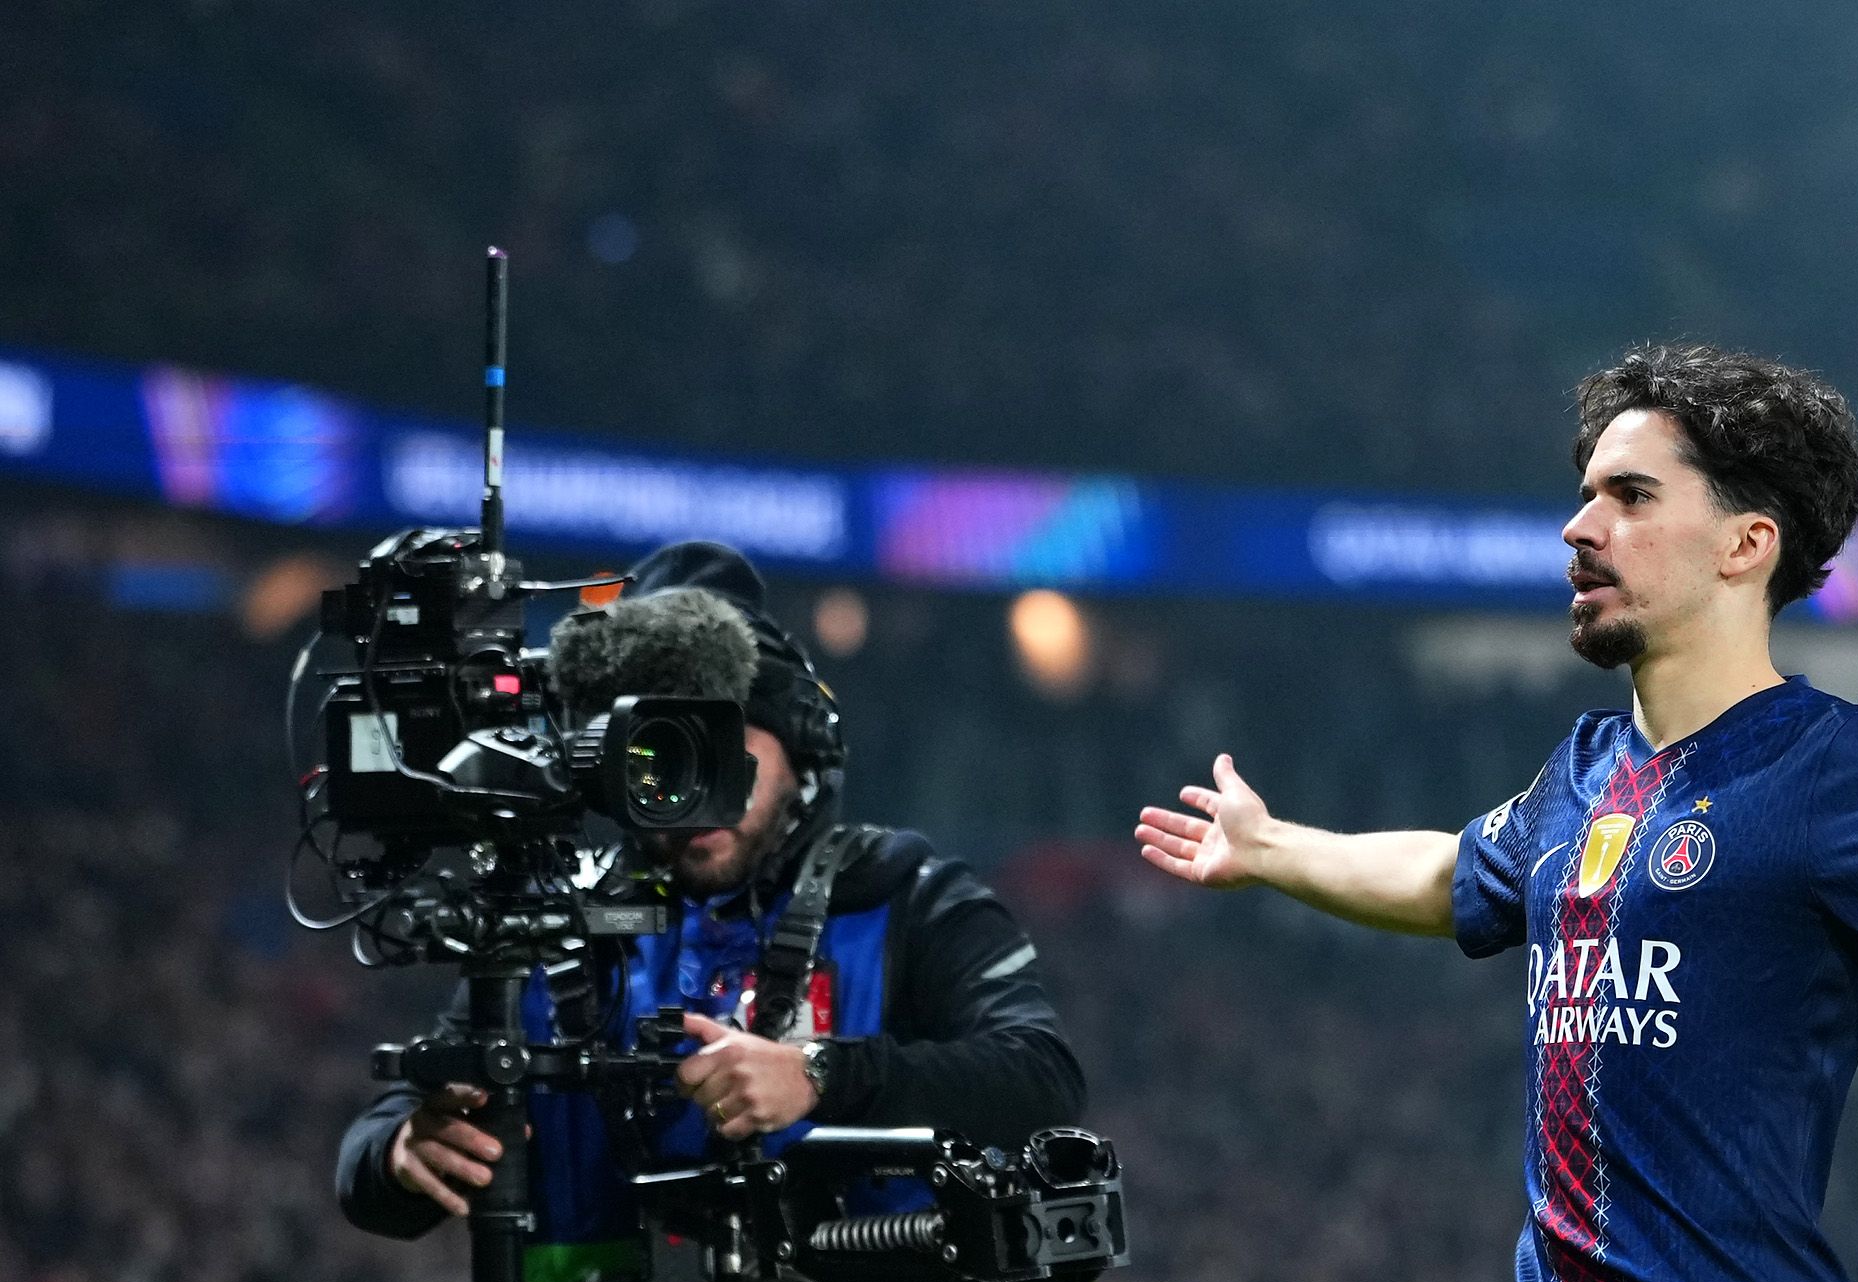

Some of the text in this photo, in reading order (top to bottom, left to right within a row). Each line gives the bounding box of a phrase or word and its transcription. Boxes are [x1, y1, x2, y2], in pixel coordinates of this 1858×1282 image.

[1667, 824, 1709, 843] PARIS
[1527, 937, 1681, 1018] QATAR
[1533, 1005, 1678, 1048] AIRWAYS
